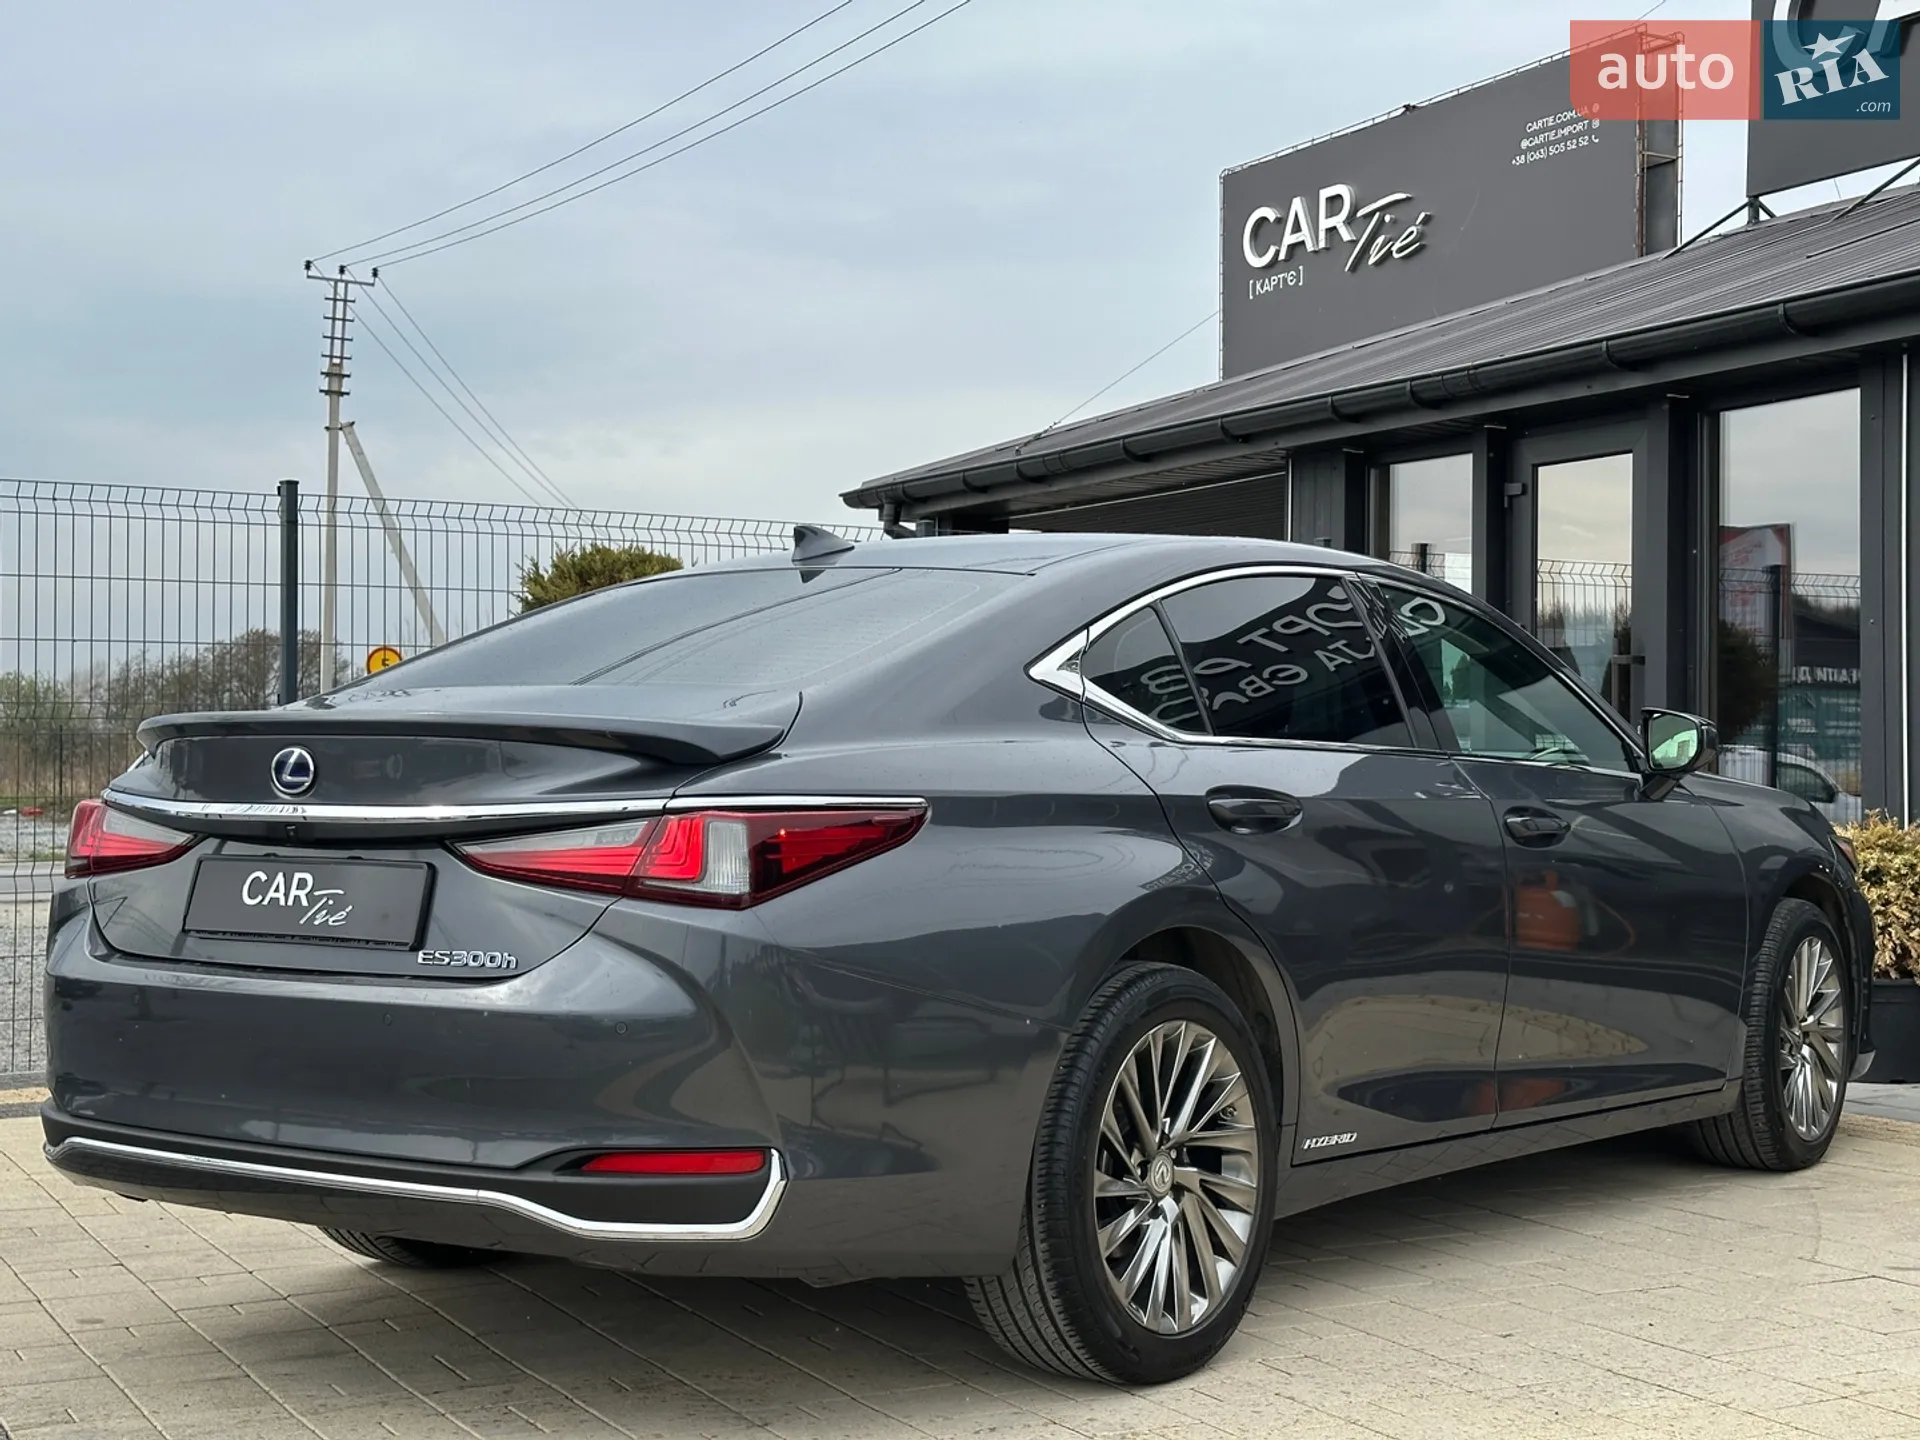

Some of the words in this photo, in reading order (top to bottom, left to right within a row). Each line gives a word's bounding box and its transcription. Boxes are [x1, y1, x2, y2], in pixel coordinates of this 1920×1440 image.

[1548, 142, 1566, 156] 505
[1566, 140, 1578, 151] 52
[1578, 135, 1590, 147] 52
[1243, 183, 1357, 268] CAR
[242, 870, 314, 908] CAR
[417, 949, 517, 969] ES300h
